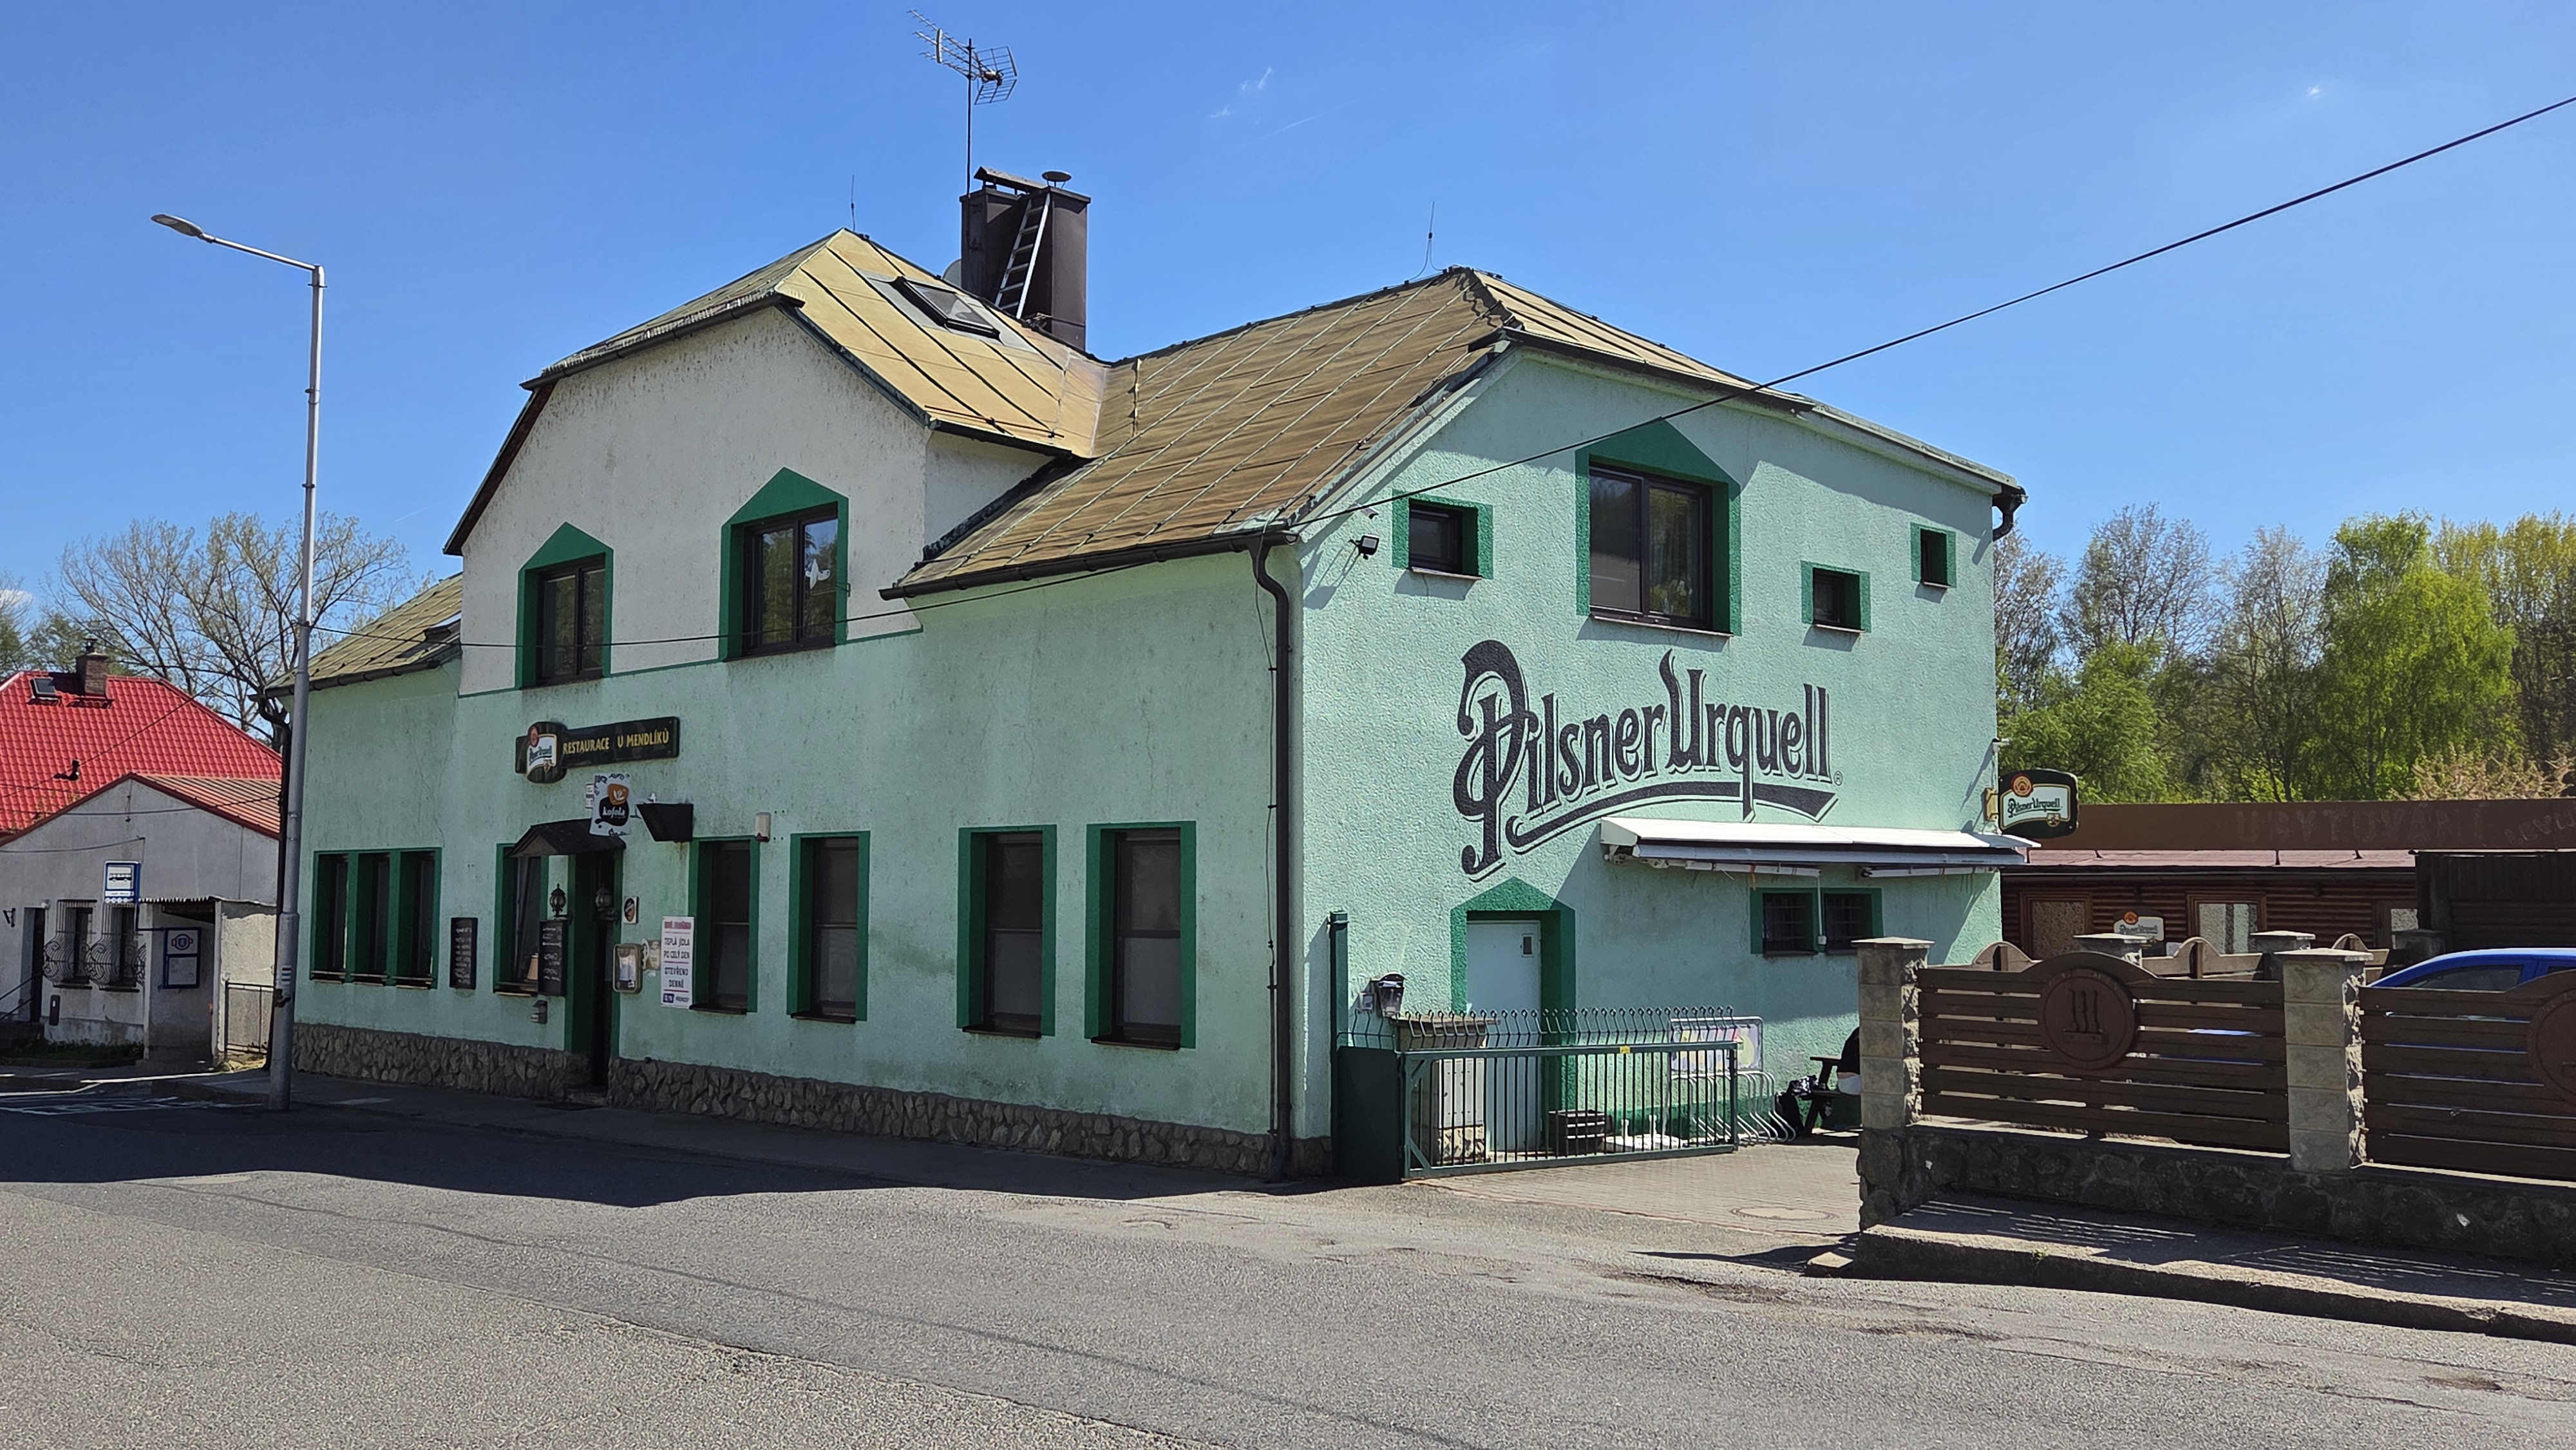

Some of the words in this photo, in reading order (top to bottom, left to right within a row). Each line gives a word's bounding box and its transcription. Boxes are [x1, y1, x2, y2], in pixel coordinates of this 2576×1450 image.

[563, 737, 610, 755] RESTAURACE
[618, 737, 625, 748] U
[626, 728, 669, 747] MENDLÍKŮ
[1453, 639, 1667, 881] Pilsner
[1660, 648, 1832, 822] Urquell
[2007, 798, 2033, 818] Pilsner
[2032, 797, 2060, 812] Urquell
